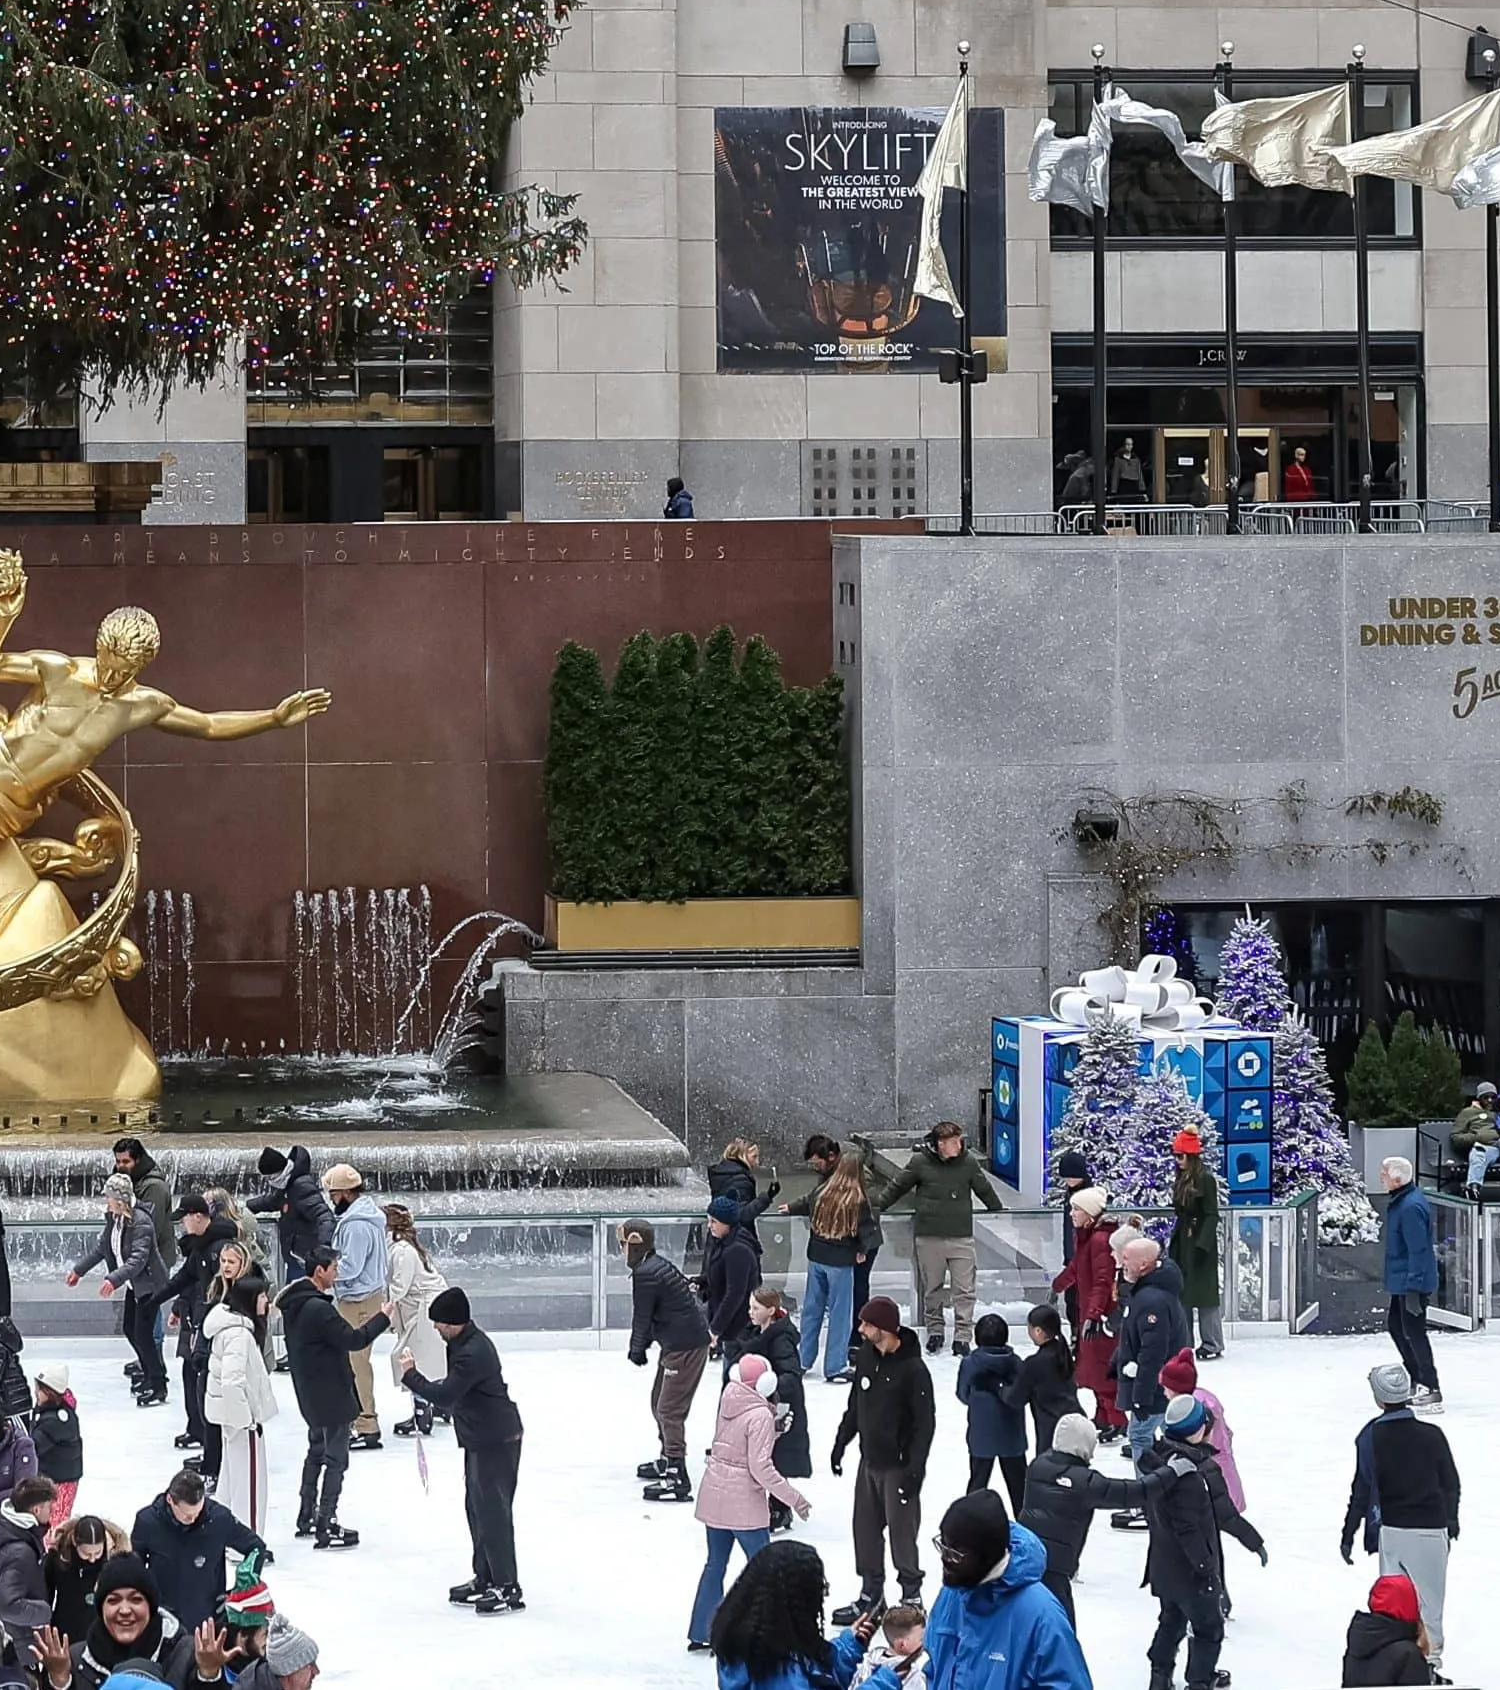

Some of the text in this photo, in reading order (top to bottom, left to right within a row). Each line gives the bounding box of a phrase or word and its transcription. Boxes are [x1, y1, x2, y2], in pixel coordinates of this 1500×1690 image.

[832, 121, 888, 129] INTRODUCING
[784, 133, 936, 171] SKYLIFT
[820, 175, 901, 186] WELCOME TO
[801, 187, 919, 198] THE GREATEST VIEW
[818, 199, 904, 210] IN THE WORLD
[814, 343, 836, 355] TOP
[838, 343, 855, 355] OF
[857, 343, 876, 355] THE
[1199, 349, 1248, 366] J.CRW
[464, 529, 536, 543] THE
[591, 527, 694, 542] FIRE
[112, 550, 250, 564] MEANS
[305, 550, 348, 563] TO
[1389, 596, 1478, 619] UNDER
[1360, 623, 1456, 646] DINING
[1461, 623, 1482, 645] &
[1452, 666, 1479, 719] 5
